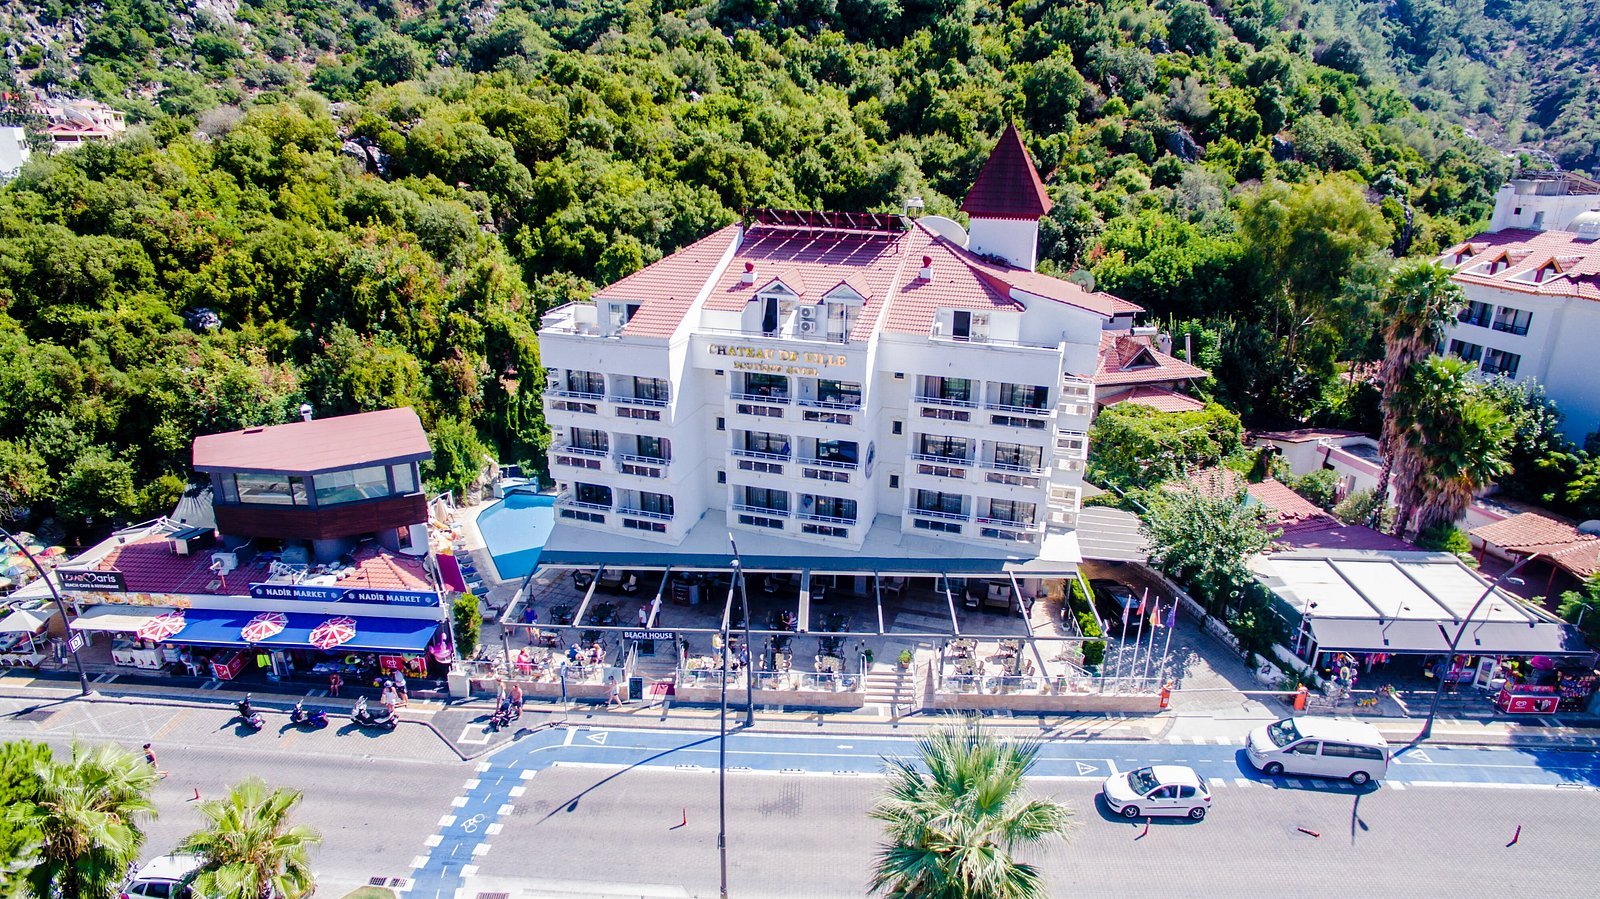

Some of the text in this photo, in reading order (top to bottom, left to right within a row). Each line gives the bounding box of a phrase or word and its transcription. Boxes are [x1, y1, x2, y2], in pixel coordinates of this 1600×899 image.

[707, 343, 847, 367] CHATEAU DE VILLE
[293, 590, 327, 598] MARKET
[386, 595, 421, 603] MARKET
